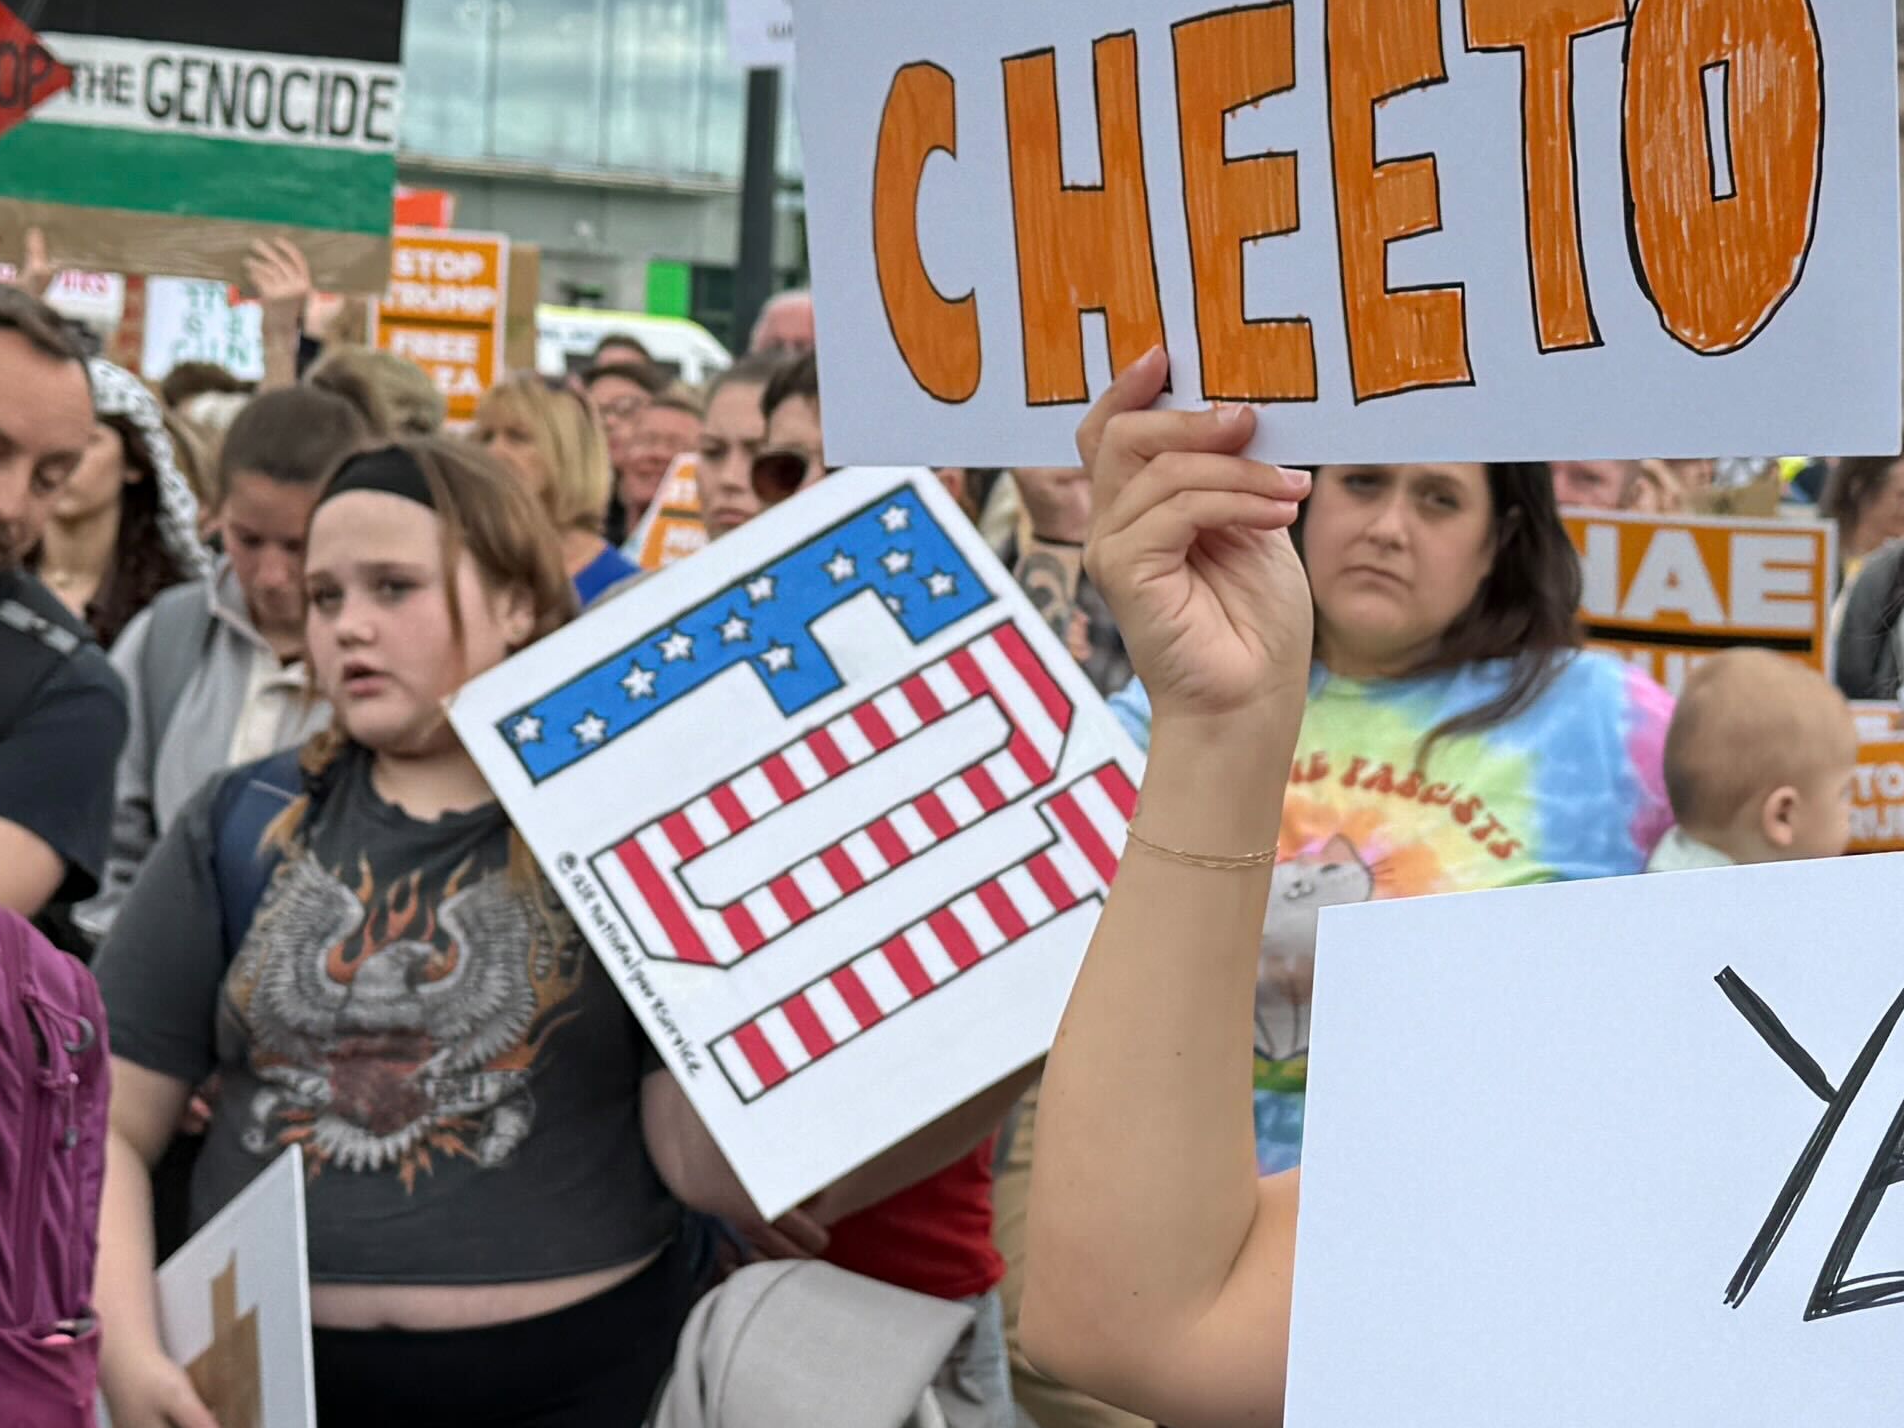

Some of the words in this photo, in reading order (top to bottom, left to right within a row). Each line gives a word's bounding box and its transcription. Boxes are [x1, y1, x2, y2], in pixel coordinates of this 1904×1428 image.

[66, 59, 136, 106] THE
[144, 55, 395, 143] GENOCIDE
[398, 248, 485, 281] STOP
